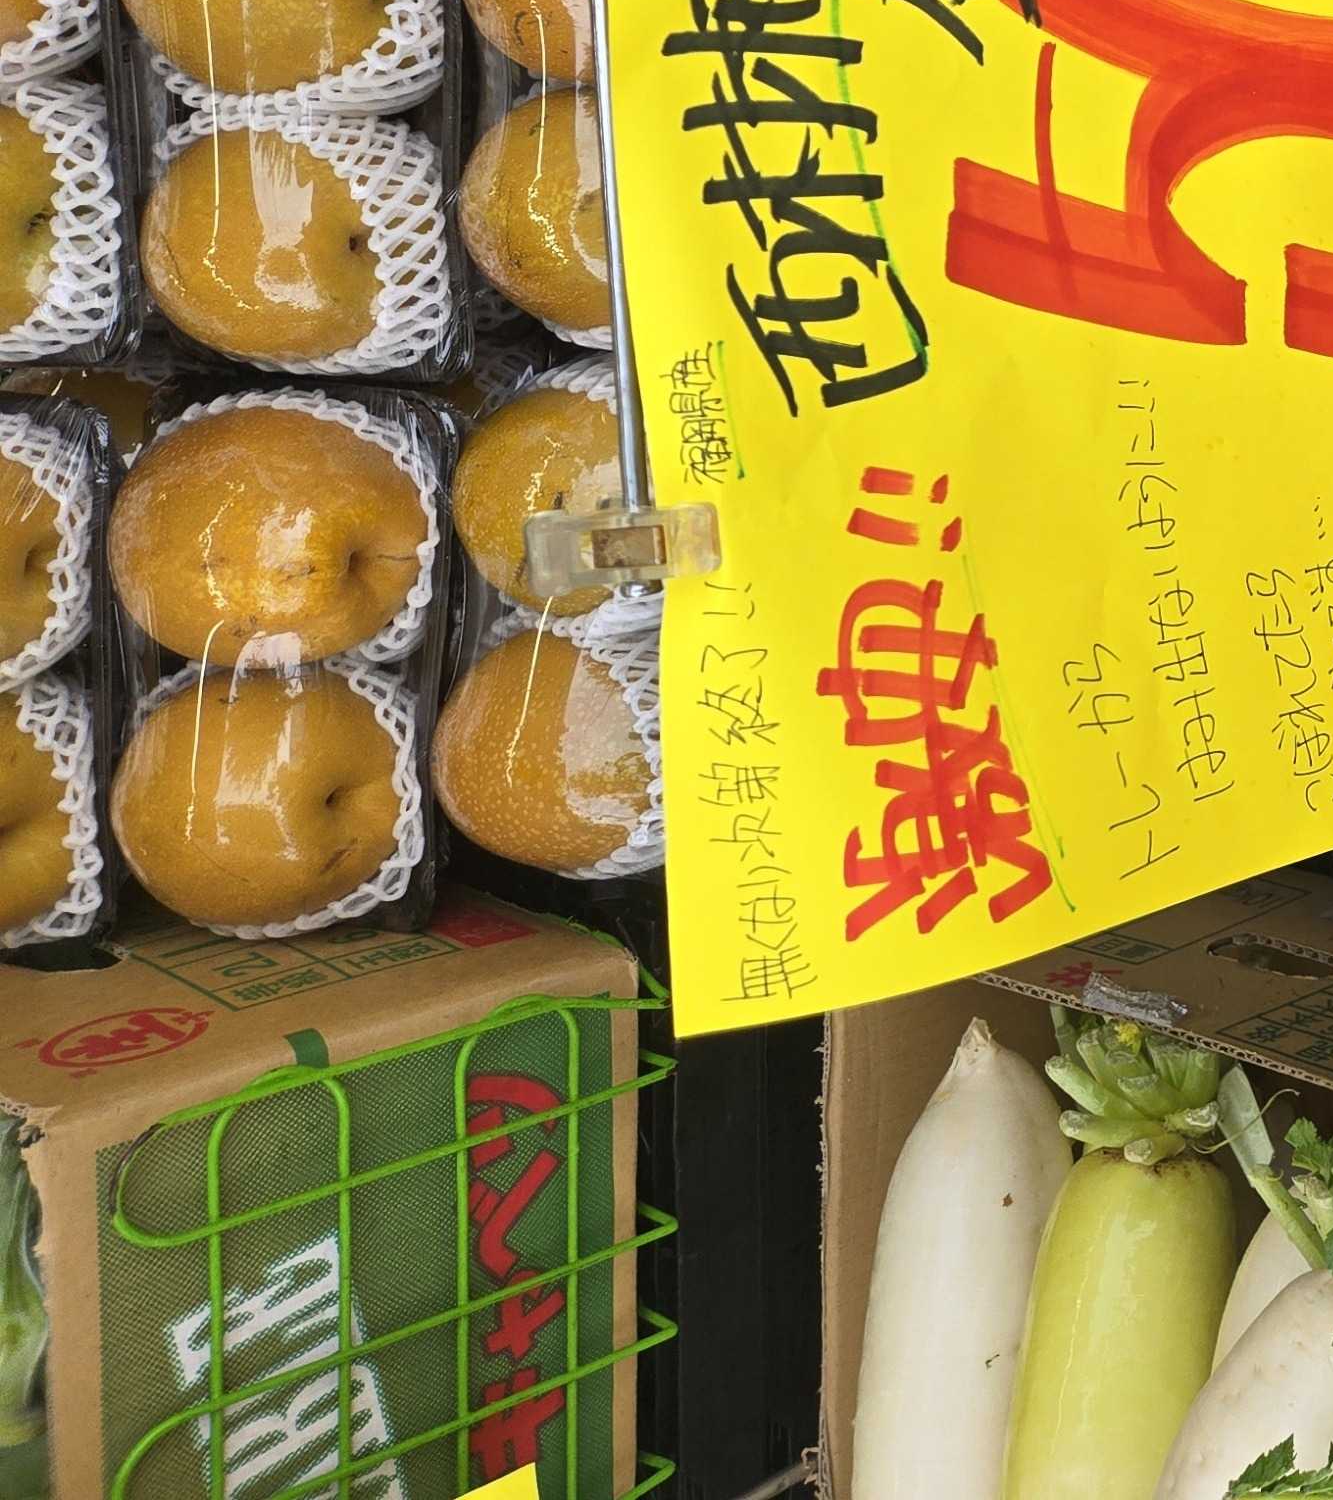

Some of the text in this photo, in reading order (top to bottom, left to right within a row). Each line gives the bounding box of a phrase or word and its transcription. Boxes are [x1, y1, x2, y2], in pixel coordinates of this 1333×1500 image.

[658, 341, 733, 485] 福岡県産
[1062, 643, 1180, 879] トレーから
[164, 1230, 408, 1500] BLE
[468, 1074, 566, 1480] キャベツ
